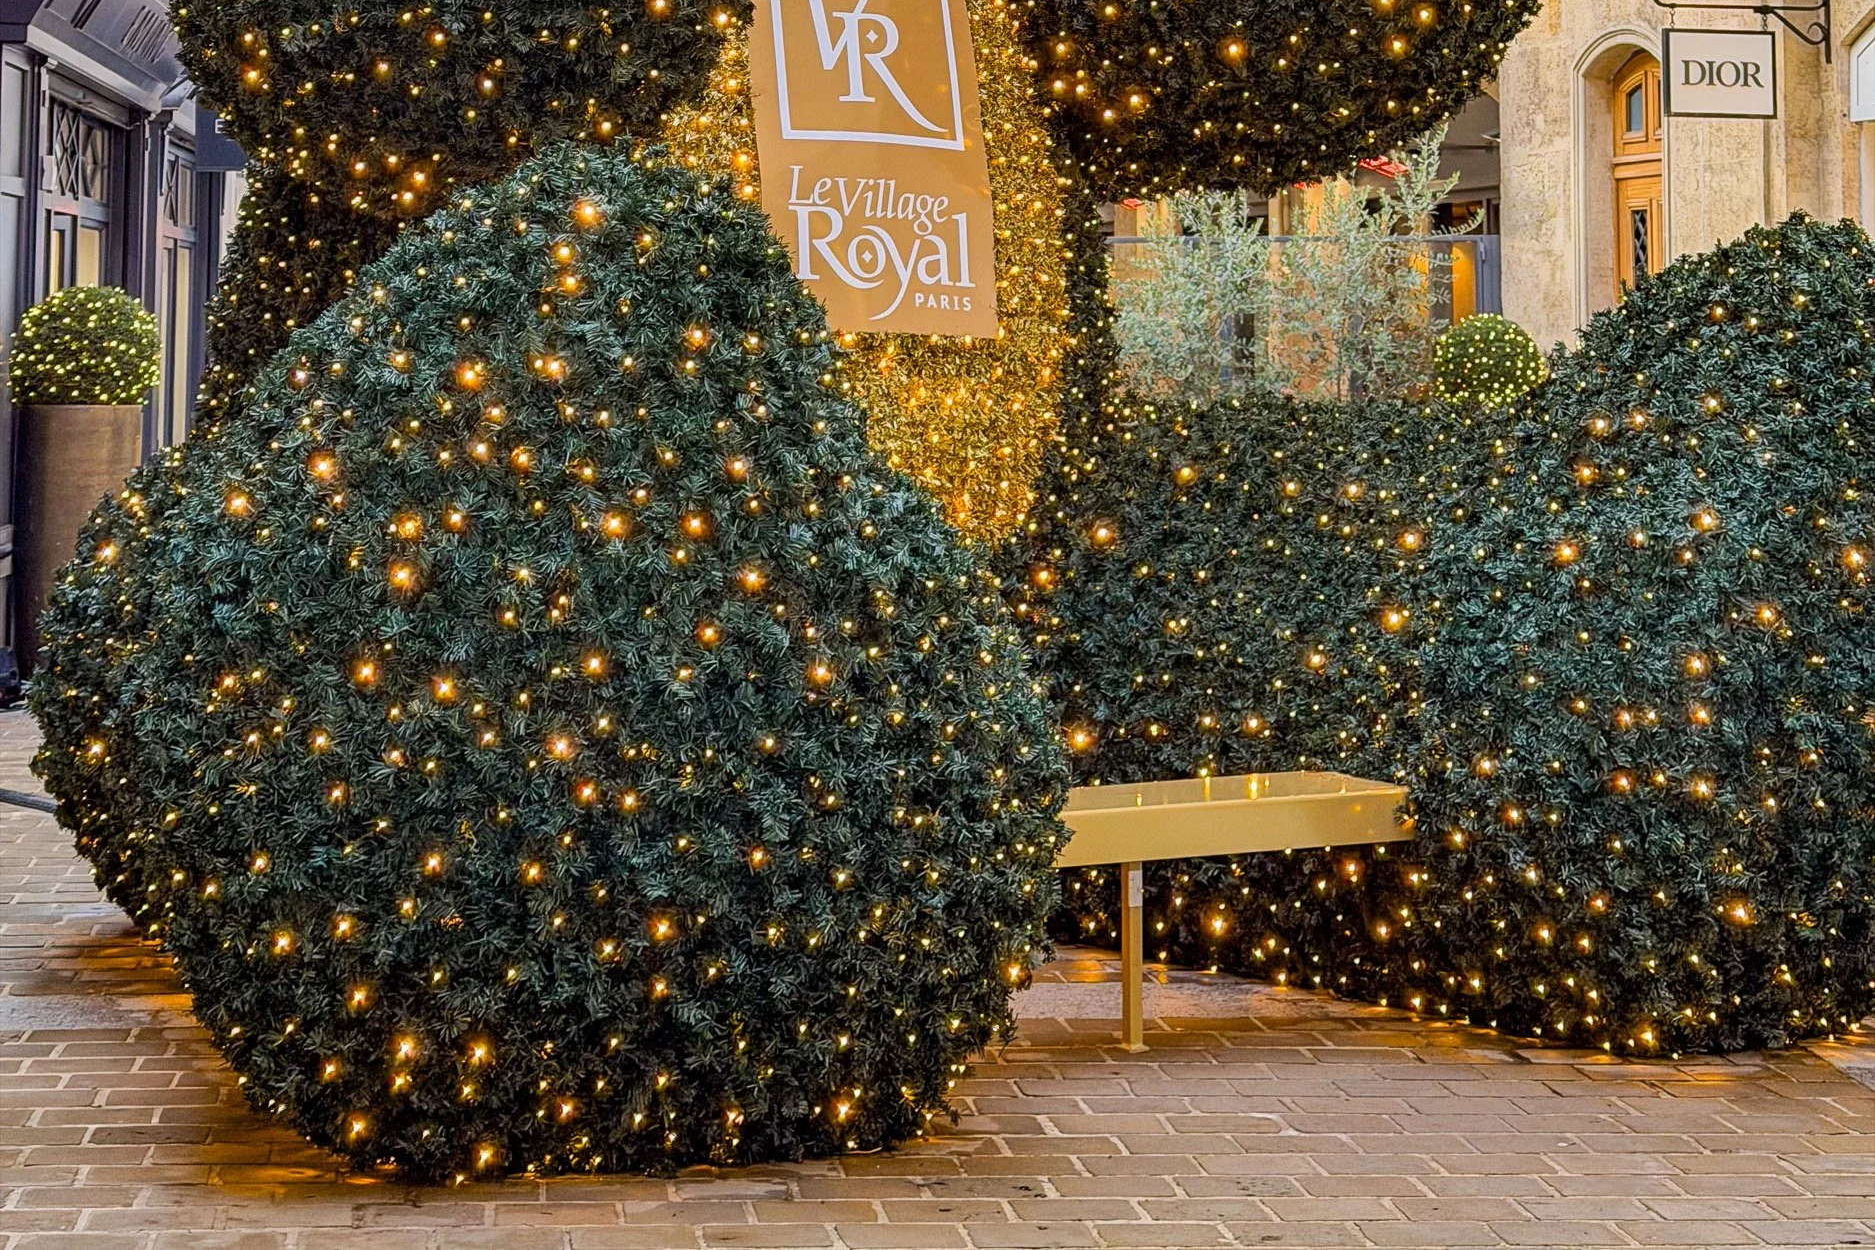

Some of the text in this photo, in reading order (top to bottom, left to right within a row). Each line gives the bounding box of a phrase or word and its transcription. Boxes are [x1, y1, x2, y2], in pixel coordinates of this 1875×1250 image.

[1681, 59, 1765, 88] DIOR
[788, 165, 949, 235] Le Village
[788, 205, 976, 321] Royal
[914, 292, 972, 311] PARIS
